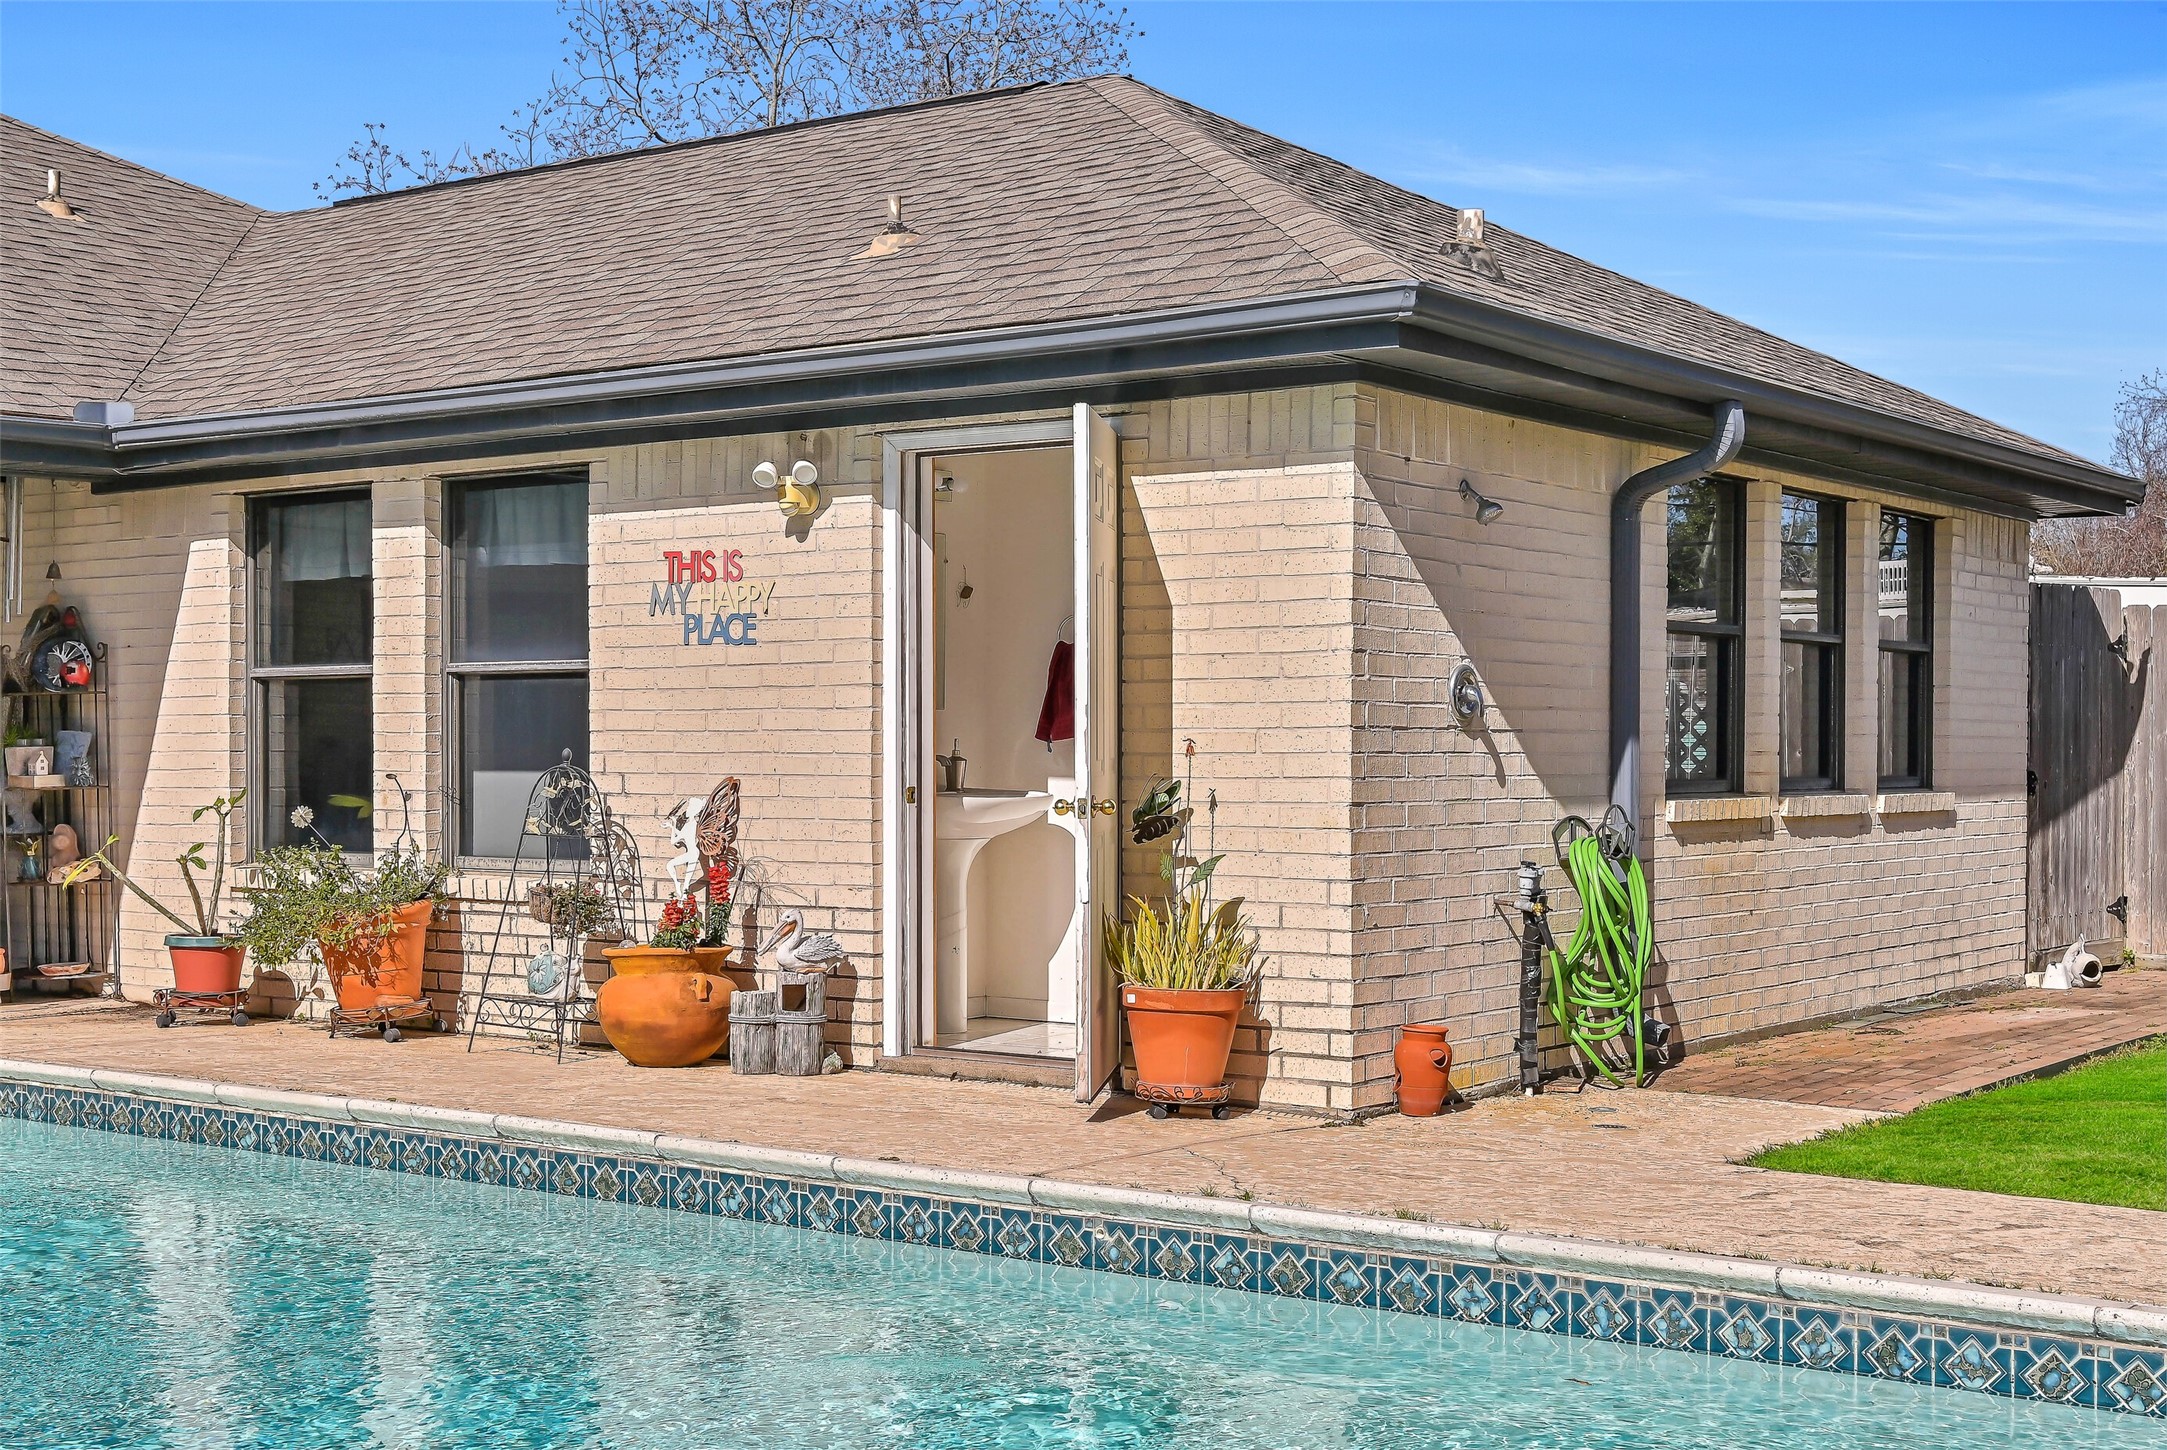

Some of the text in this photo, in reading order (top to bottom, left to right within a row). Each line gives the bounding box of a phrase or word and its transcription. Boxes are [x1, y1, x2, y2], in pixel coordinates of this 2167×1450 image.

[663, 549, 744, 584] THIS IS
[649, 580, 776, 616] MY HAPPY
[684, 613, 757, 645] PLACE
